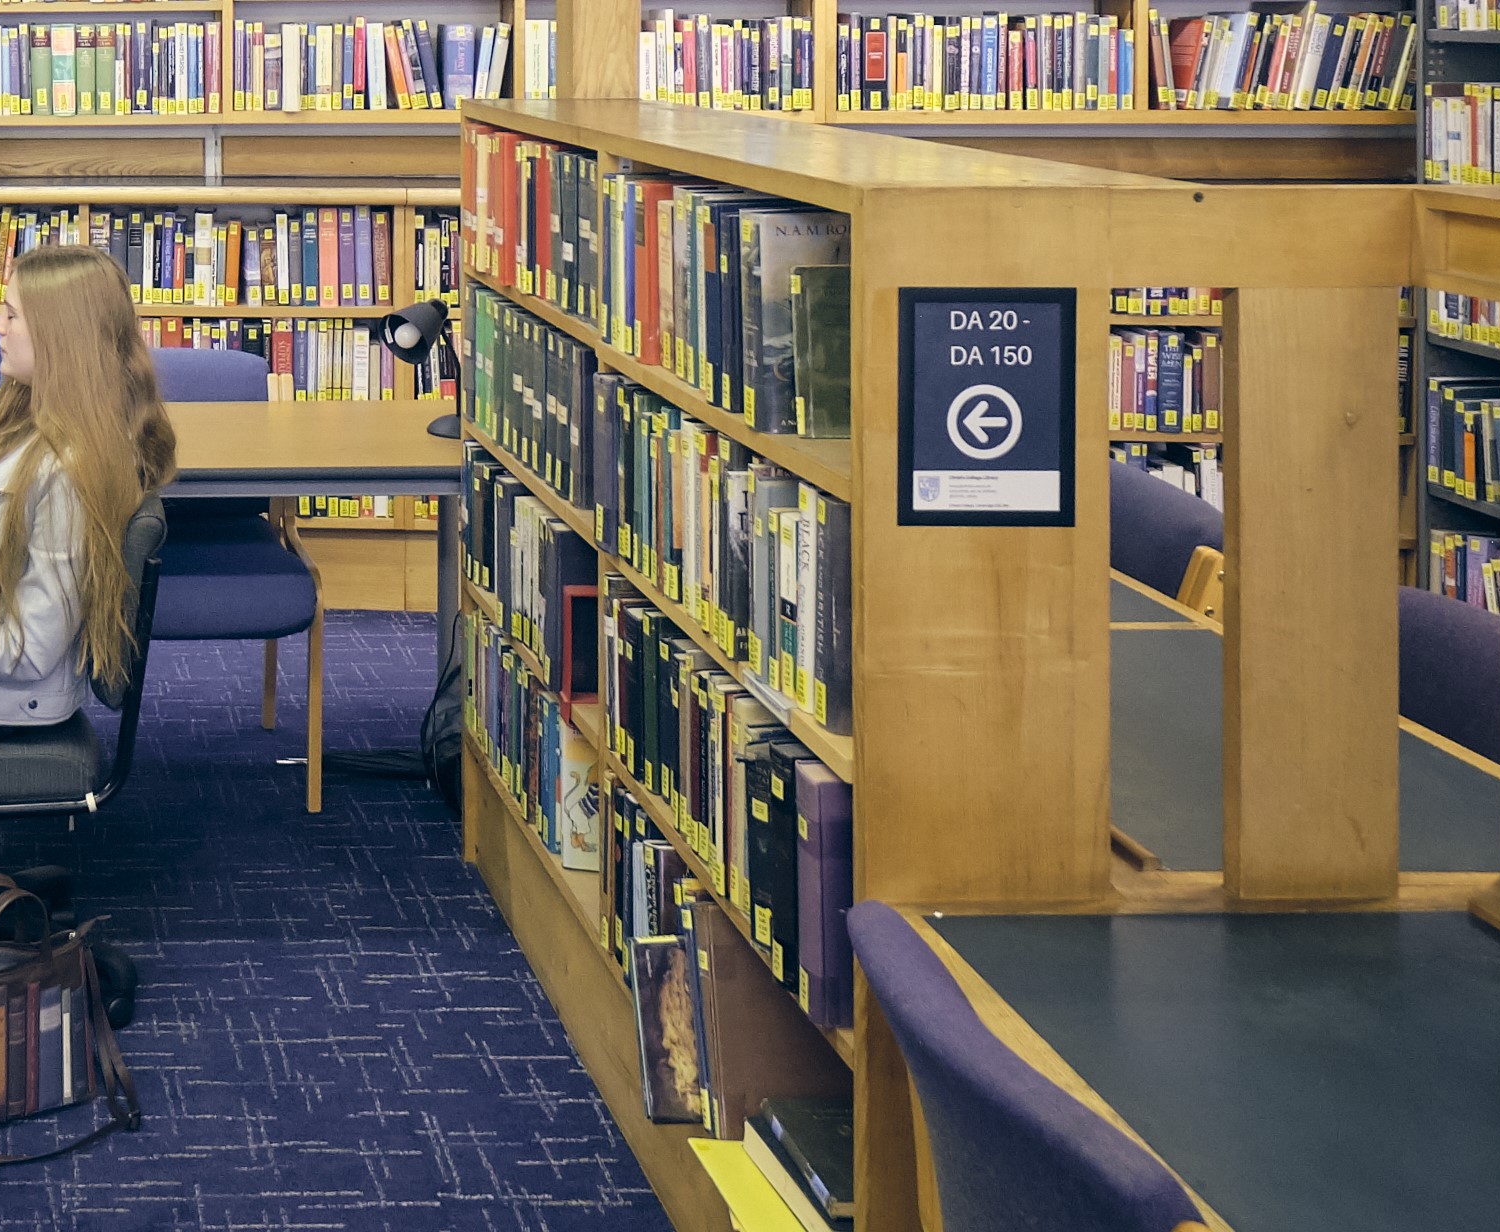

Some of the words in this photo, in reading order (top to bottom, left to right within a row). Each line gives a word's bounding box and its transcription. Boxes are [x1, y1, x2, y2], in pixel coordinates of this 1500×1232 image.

[826, 224, 850, 235] RO
[950, 311, 984, 330] DA
[989, 311, 1017, 330] 20
[278, 340, 286, 372] SUPER
[950, 346, 984, 365] DA
[991, 346, 1032, 365] 150
[800, 518, 812, 572] BLACK
[816, 526, 825, 562] ACK
[816, 564, 824, 588] AND
[815, 590, 825, 654] BRITISH
